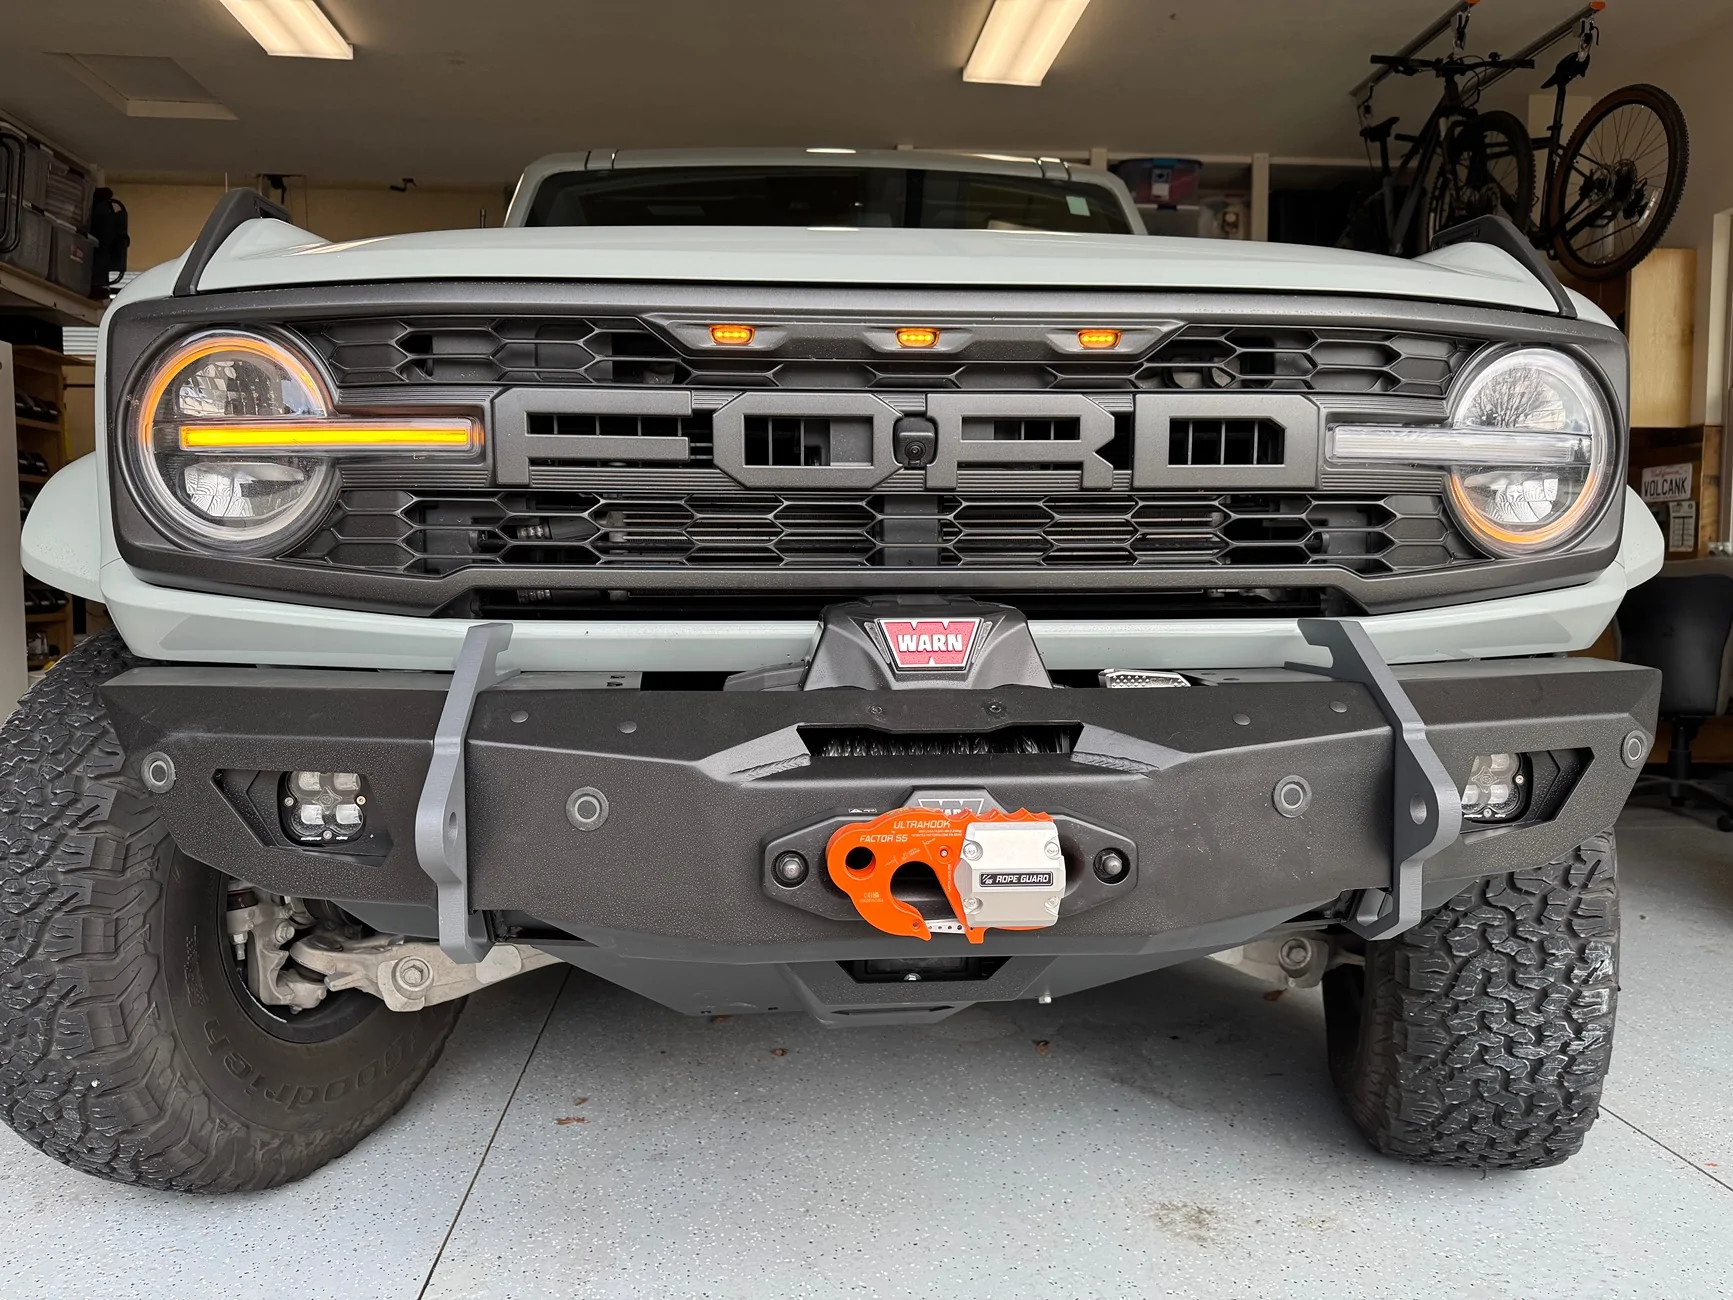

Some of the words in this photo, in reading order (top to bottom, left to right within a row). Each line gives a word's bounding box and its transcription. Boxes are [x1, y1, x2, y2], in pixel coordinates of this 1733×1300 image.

[494, 388, 1319, 489] FORD
[1643, 477, 1687, 497] VOLCANK
[896, 633, 963, 653] WARN
[893, 819, 951, 829] ULTRAHOOK
[859, 833, 894, 843] FACTOR
[996, 875, 1019, 883] ROPE
[1020, 874, 1049, 883] GUARD
